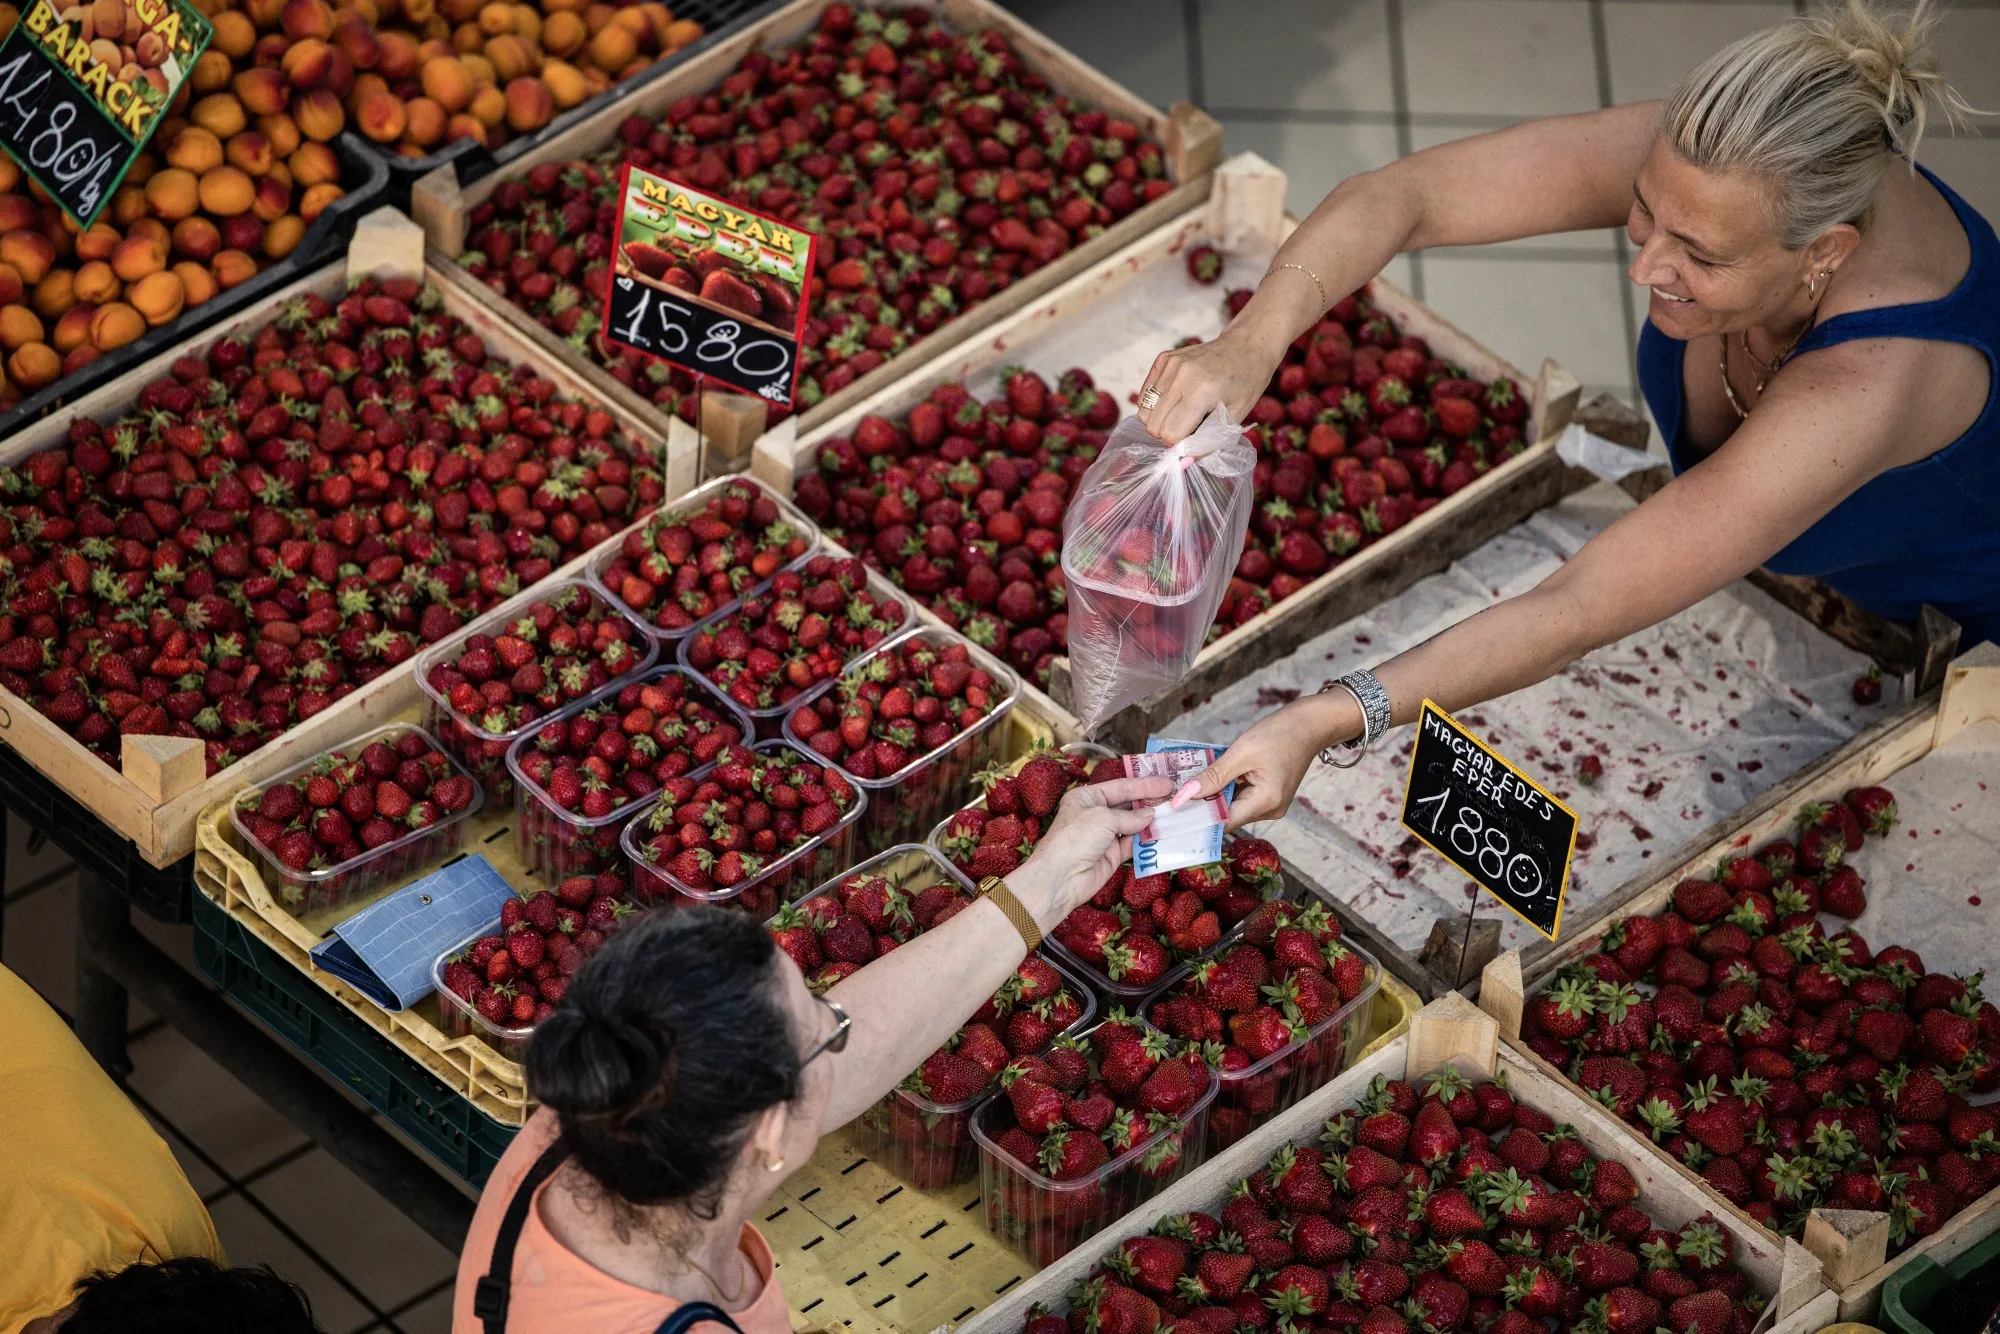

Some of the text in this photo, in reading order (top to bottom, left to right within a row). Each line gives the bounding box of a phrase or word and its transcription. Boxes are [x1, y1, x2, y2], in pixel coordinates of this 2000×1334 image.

[26, 0, 153, 137] BARACK
[629, 195, 801, 284] EPER
[641, 178, 794, 252] MAGYAR
[1424, 712, 1494, 779] MAGYAR
[1452, 760, 1505, 809] EPER
